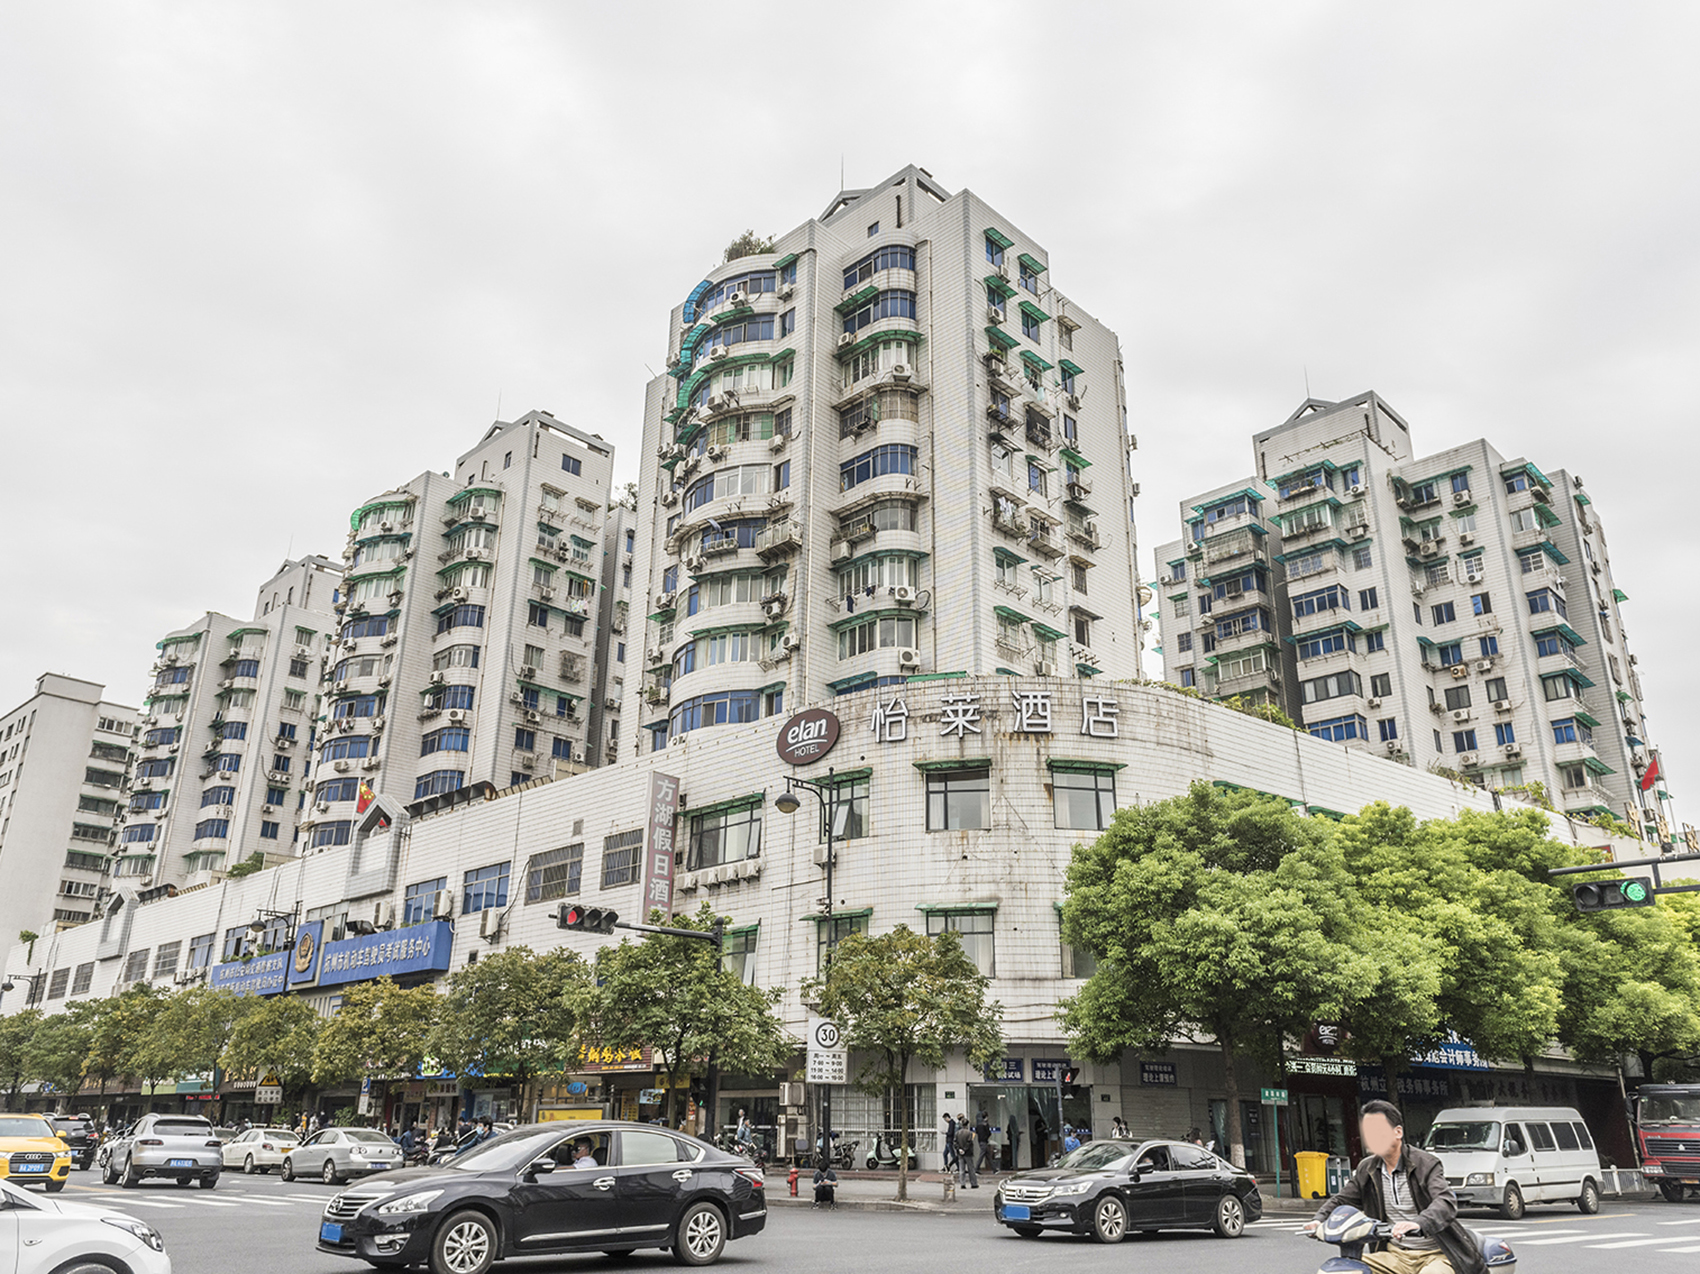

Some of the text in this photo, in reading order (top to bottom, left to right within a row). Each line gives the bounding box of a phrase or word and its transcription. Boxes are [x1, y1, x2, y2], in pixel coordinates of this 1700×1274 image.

[870, 690, 1120, 743] 怡莱酒店
[787, 718, 828, 744] elan
[794, 744, 820, 757] HOTEL
[821, 1029, 835, 1041] 30
[1359, 1074, 1449, 1096] 杭州立税务师事务所
